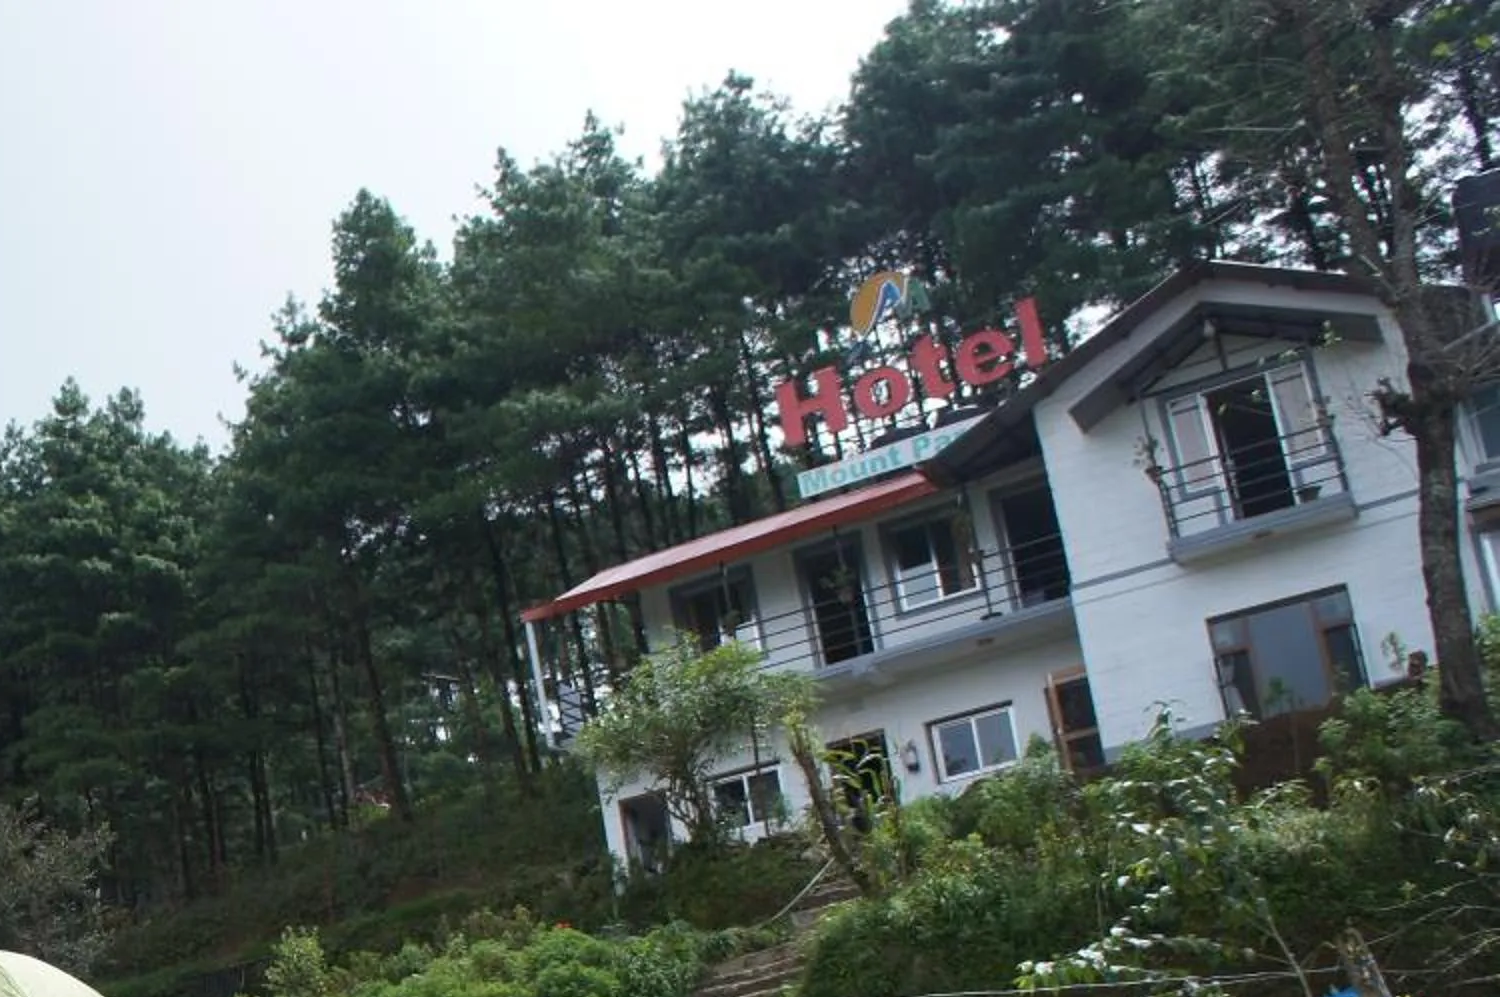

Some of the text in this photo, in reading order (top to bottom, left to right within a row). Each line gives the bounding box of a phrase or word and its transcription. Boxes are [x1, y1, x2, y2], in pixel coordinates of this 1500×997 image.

[775, 297, 1048, 446] Hotel
[802, 432, 961, 495] Mount Pa
